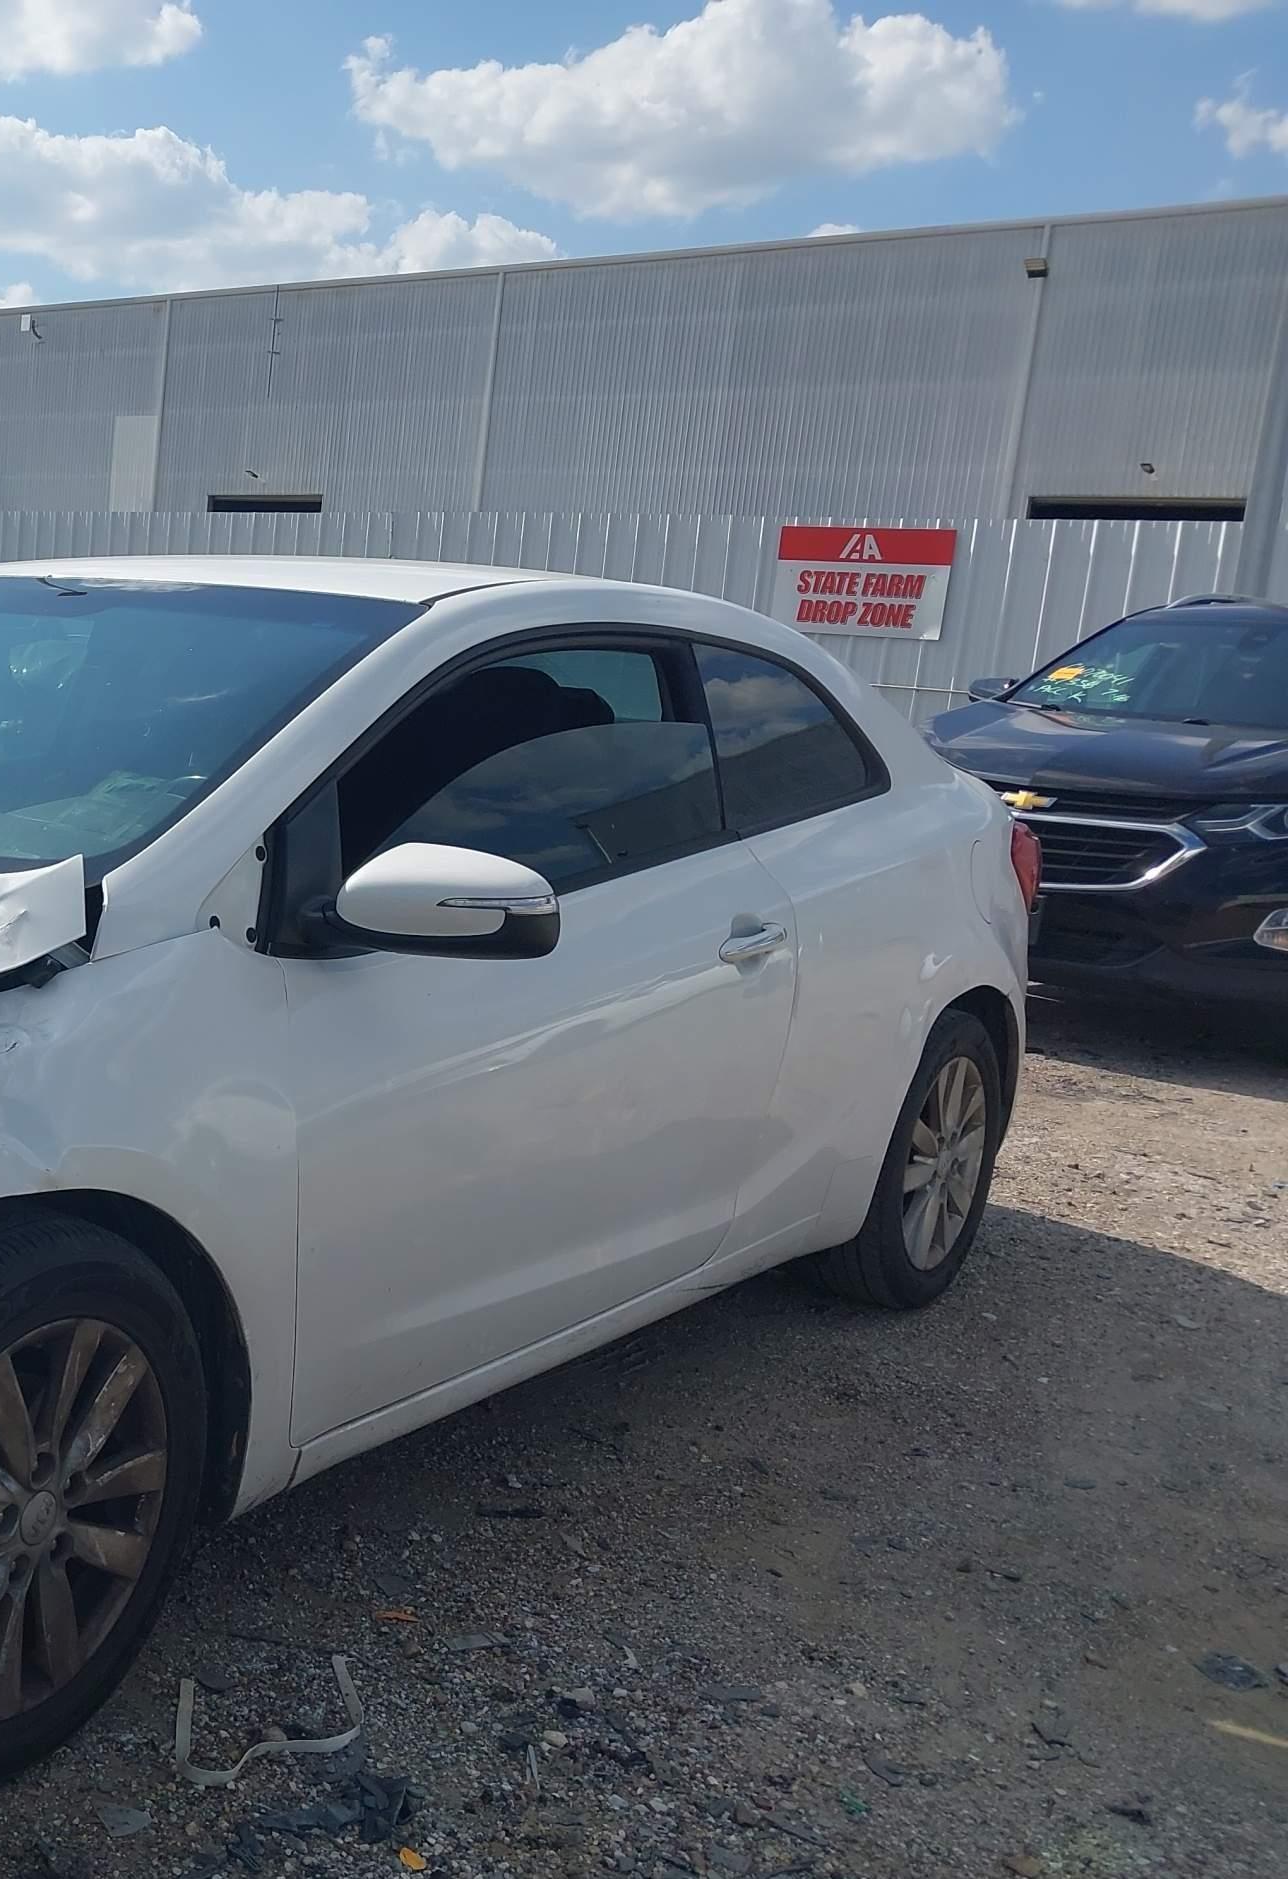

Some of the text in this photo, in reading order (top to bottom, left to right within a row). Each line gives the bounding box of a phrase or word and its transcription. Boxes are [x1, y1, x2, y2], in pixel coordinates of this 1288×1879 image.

[797, 569, 927, 600] STATE FARM
[796, 599, 916, 629] DROP ZONE
